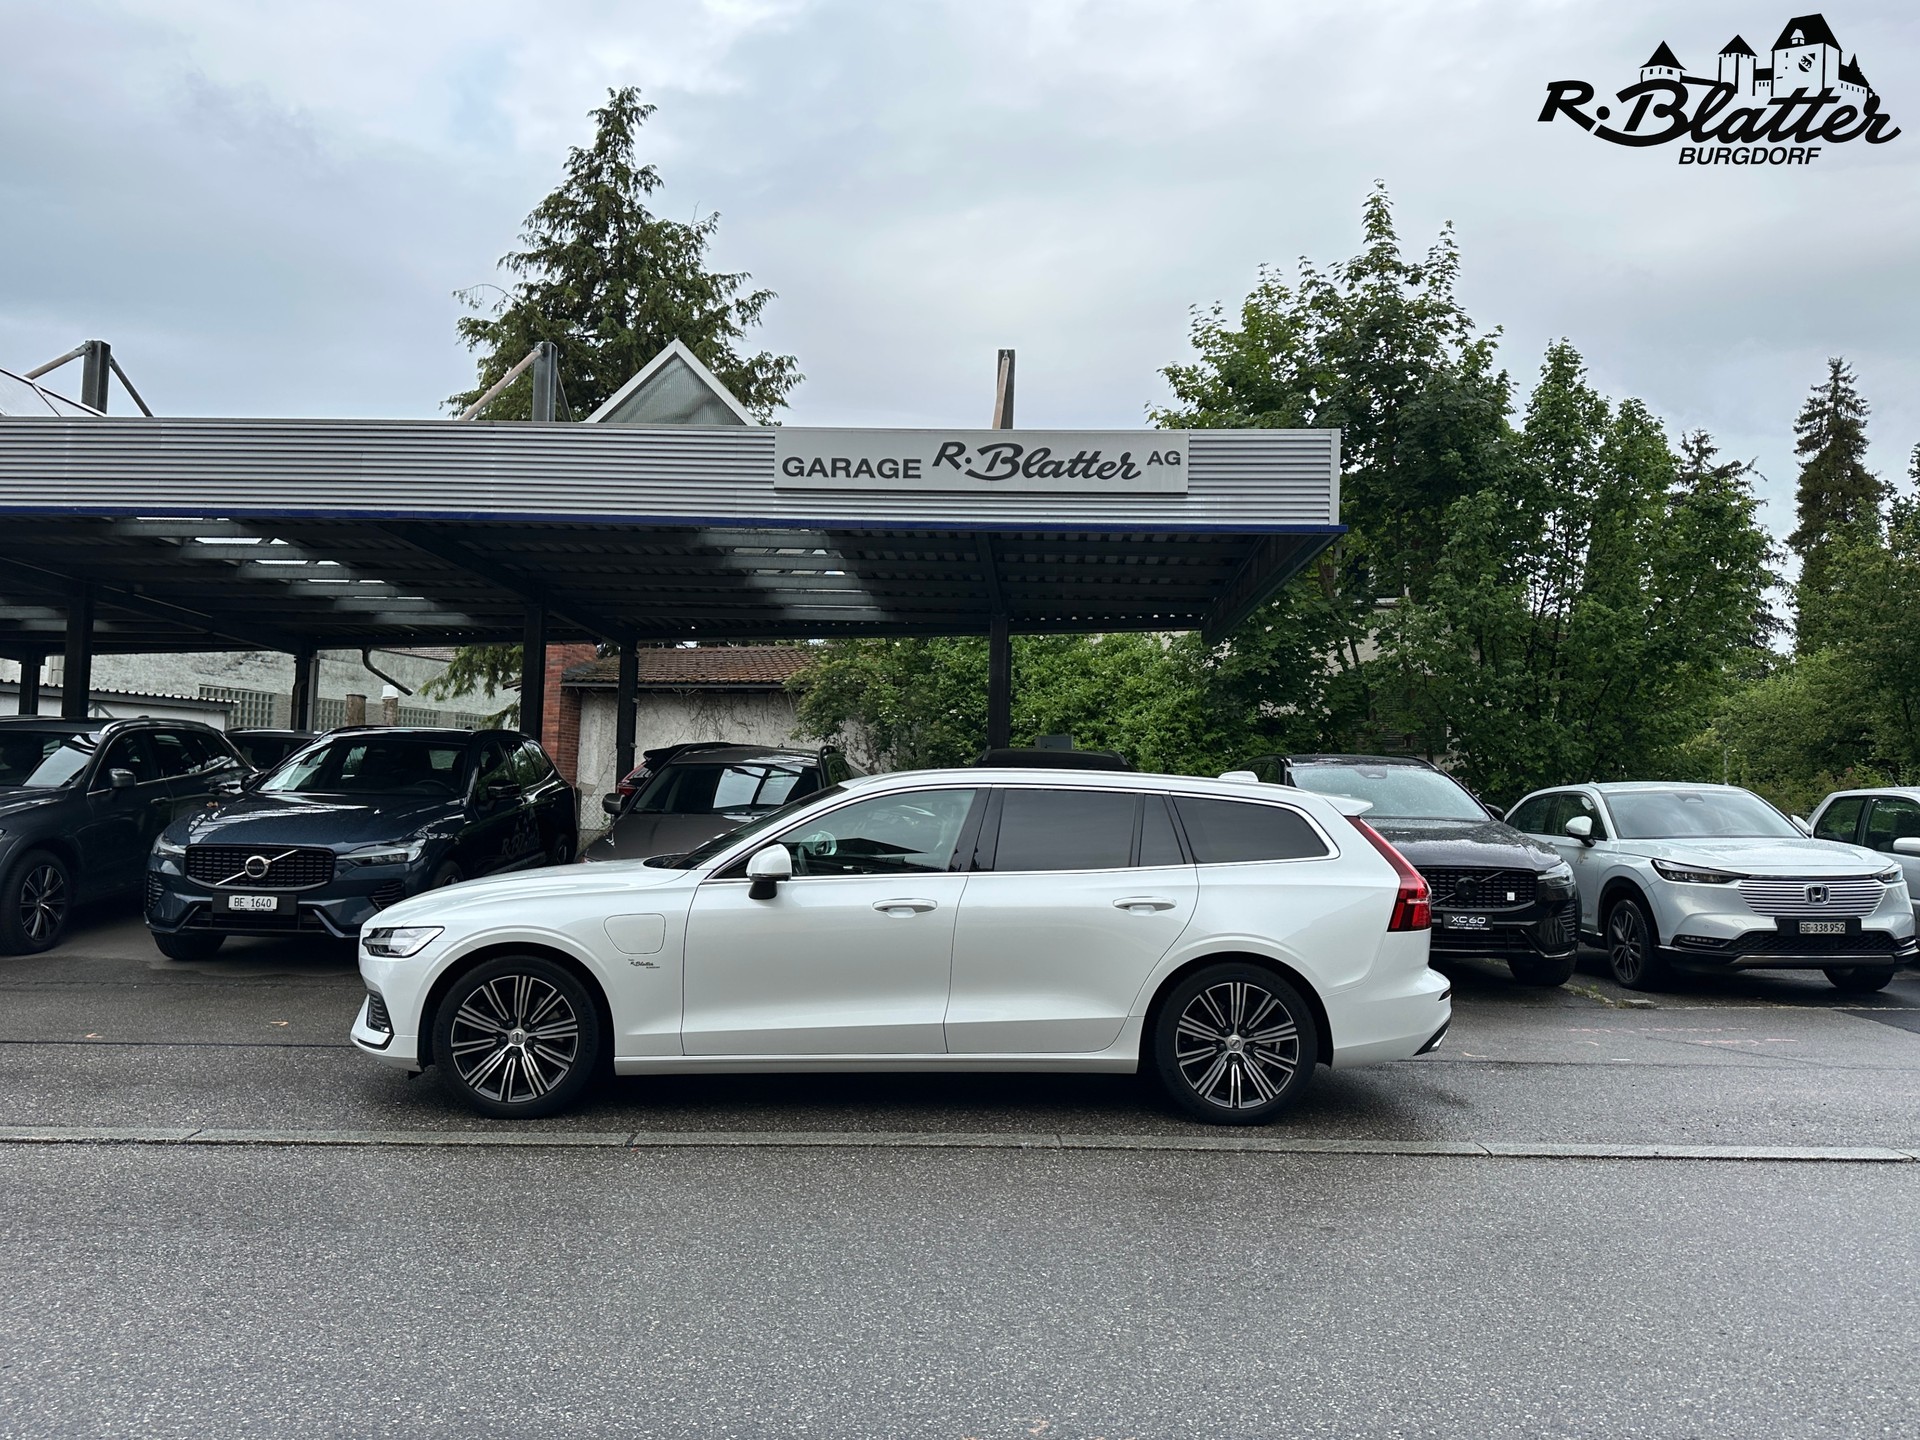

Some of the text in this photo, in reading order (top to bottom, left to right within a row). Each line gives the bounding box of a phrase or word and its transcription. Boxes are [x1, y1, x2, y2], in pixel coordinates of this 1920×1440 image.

[781, 456, 922, 480] GARAGE
[1146, 450, 1181, 467] AG
[234, 897, 272, 908] BE 1640
